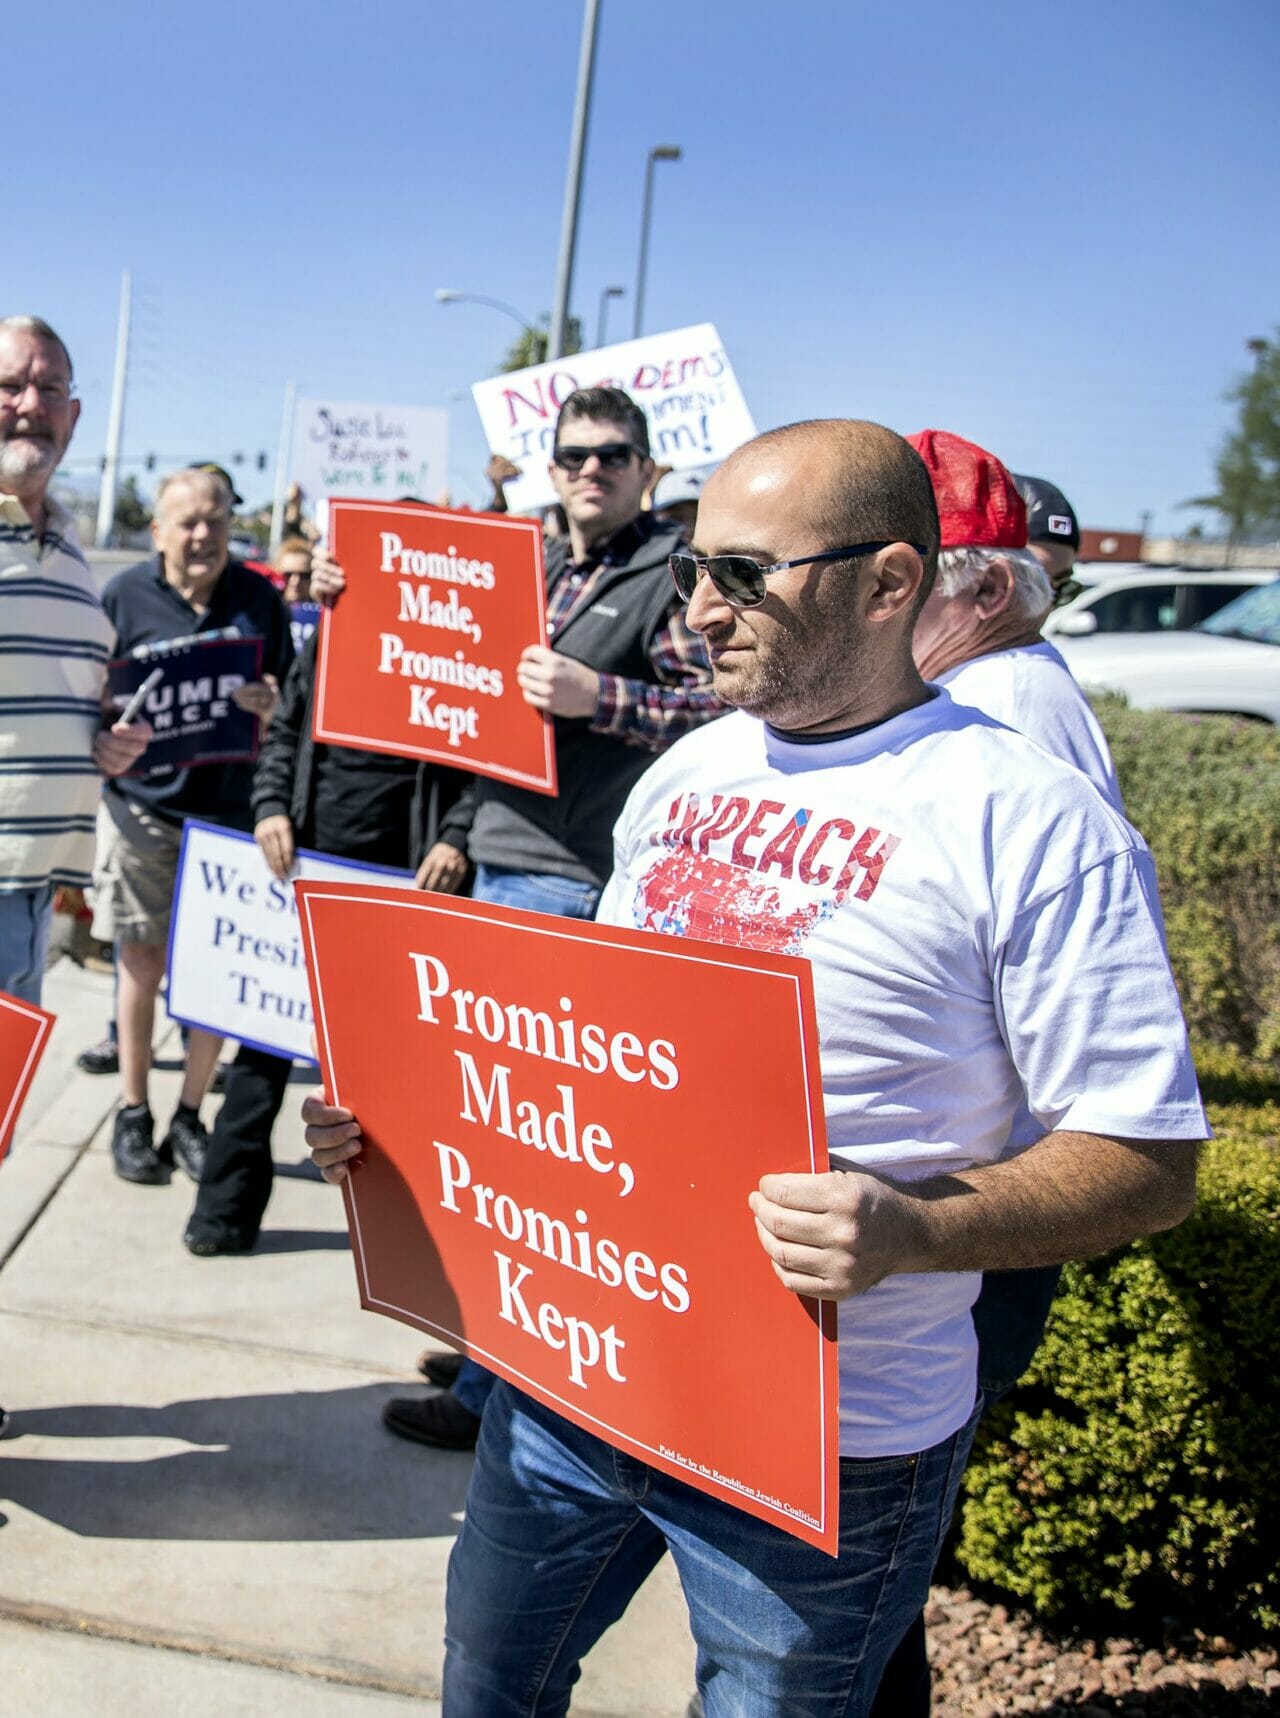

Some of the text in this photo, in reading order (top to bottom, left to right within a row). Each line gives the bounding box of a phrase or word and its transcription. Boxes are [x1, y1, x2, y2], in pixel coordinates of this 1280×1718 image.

[502, 371, 579, 427] NO
[379, 531, 496, 590] Promises
[398, 580, 482, 644] Made,
[378, 632, 504, 697] Promises
[408, 684, 479, 747] Kept
[200, 859, 256, 905] We
[212, 916, 307, 969] Presi
[408, 951, 680, 1090] Promises
[454, 1050, 635, 1198] Made,
[433, 1141, 691, 1314] Promises
[494, 1250, 627, 1389] Kept
[659, 1444, 820, 1526] Paid for by the Republican Jewish Coalition
